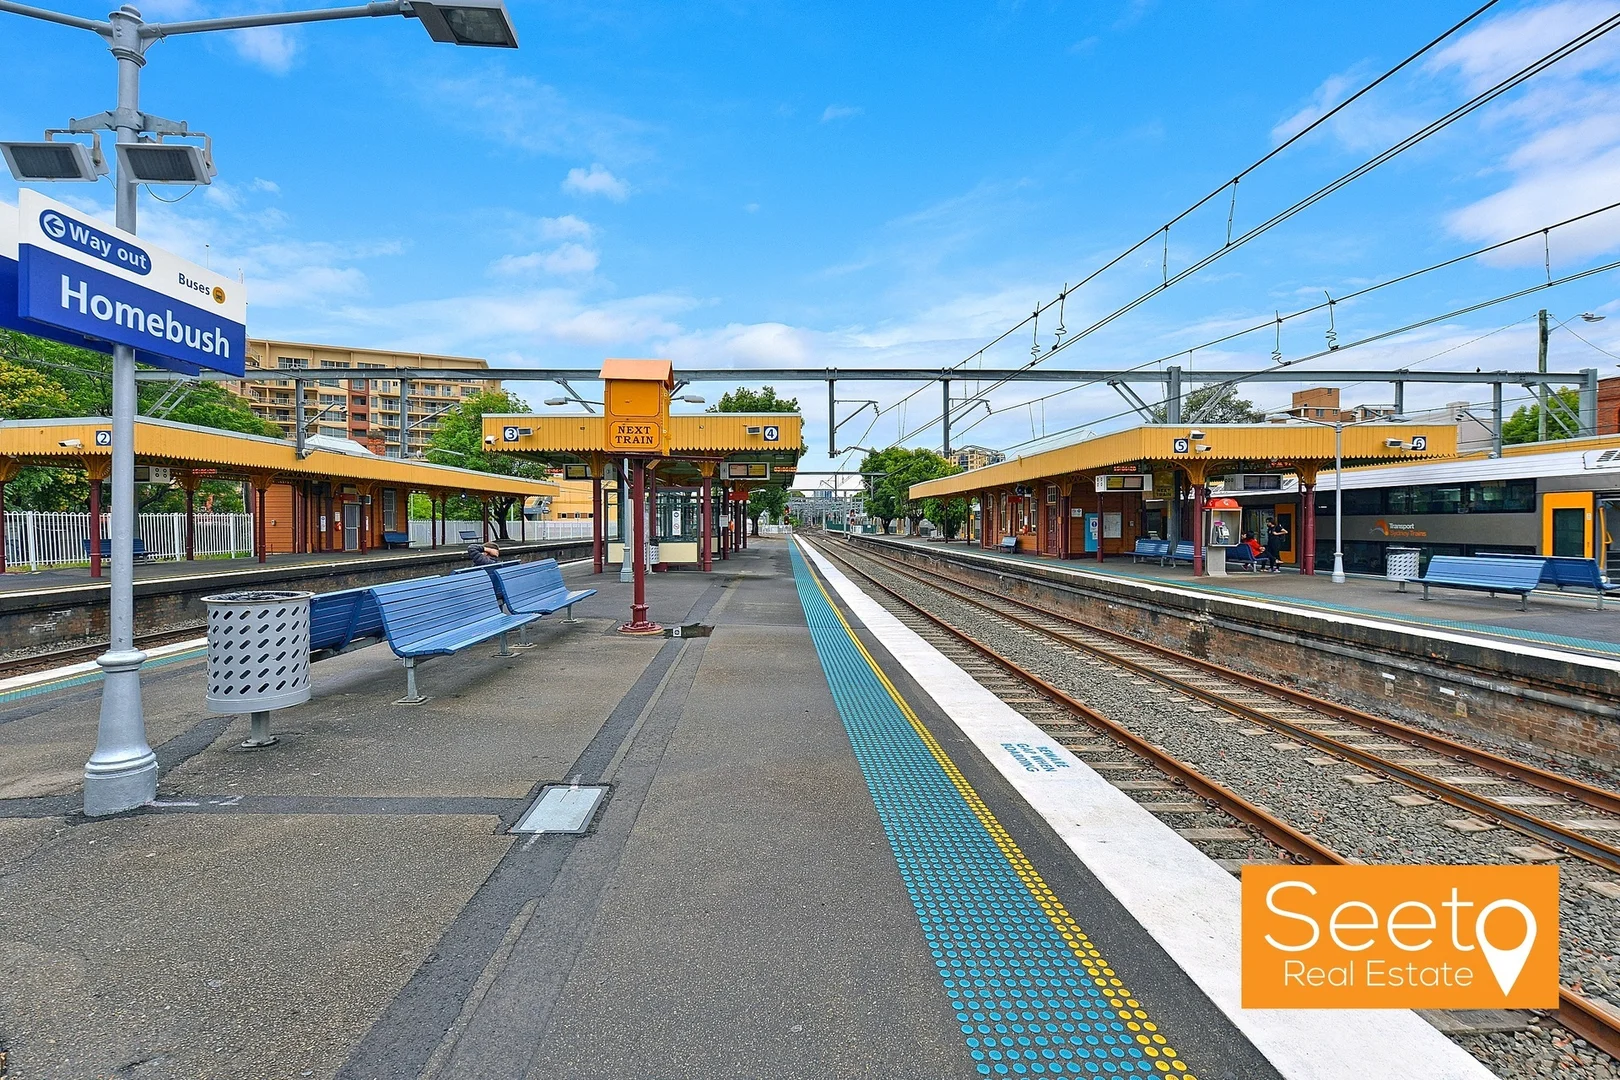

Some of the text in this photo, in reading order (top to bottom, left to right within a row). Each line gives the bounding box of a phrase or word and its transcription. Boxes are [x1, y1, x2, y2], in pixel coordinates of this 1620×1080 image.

[68, 222, 147, 270] Way out
[178, 272, 211, 296] Buses
[60, 274, 230, 359] Homebush
[507, 429, 515, 439] 3
[615, 435, 654, 444] TRAIN
[618, 425, 651, 434] NEXT
[767, 428, 775, 438] 4
[1388, 522, 1415, 530] Transport
[1000, 743, 1040, 773] BOARDING
[1016, 743, 1057, 772] GAP WHEN
[1036, 746, 1070, 769] BEWARE
